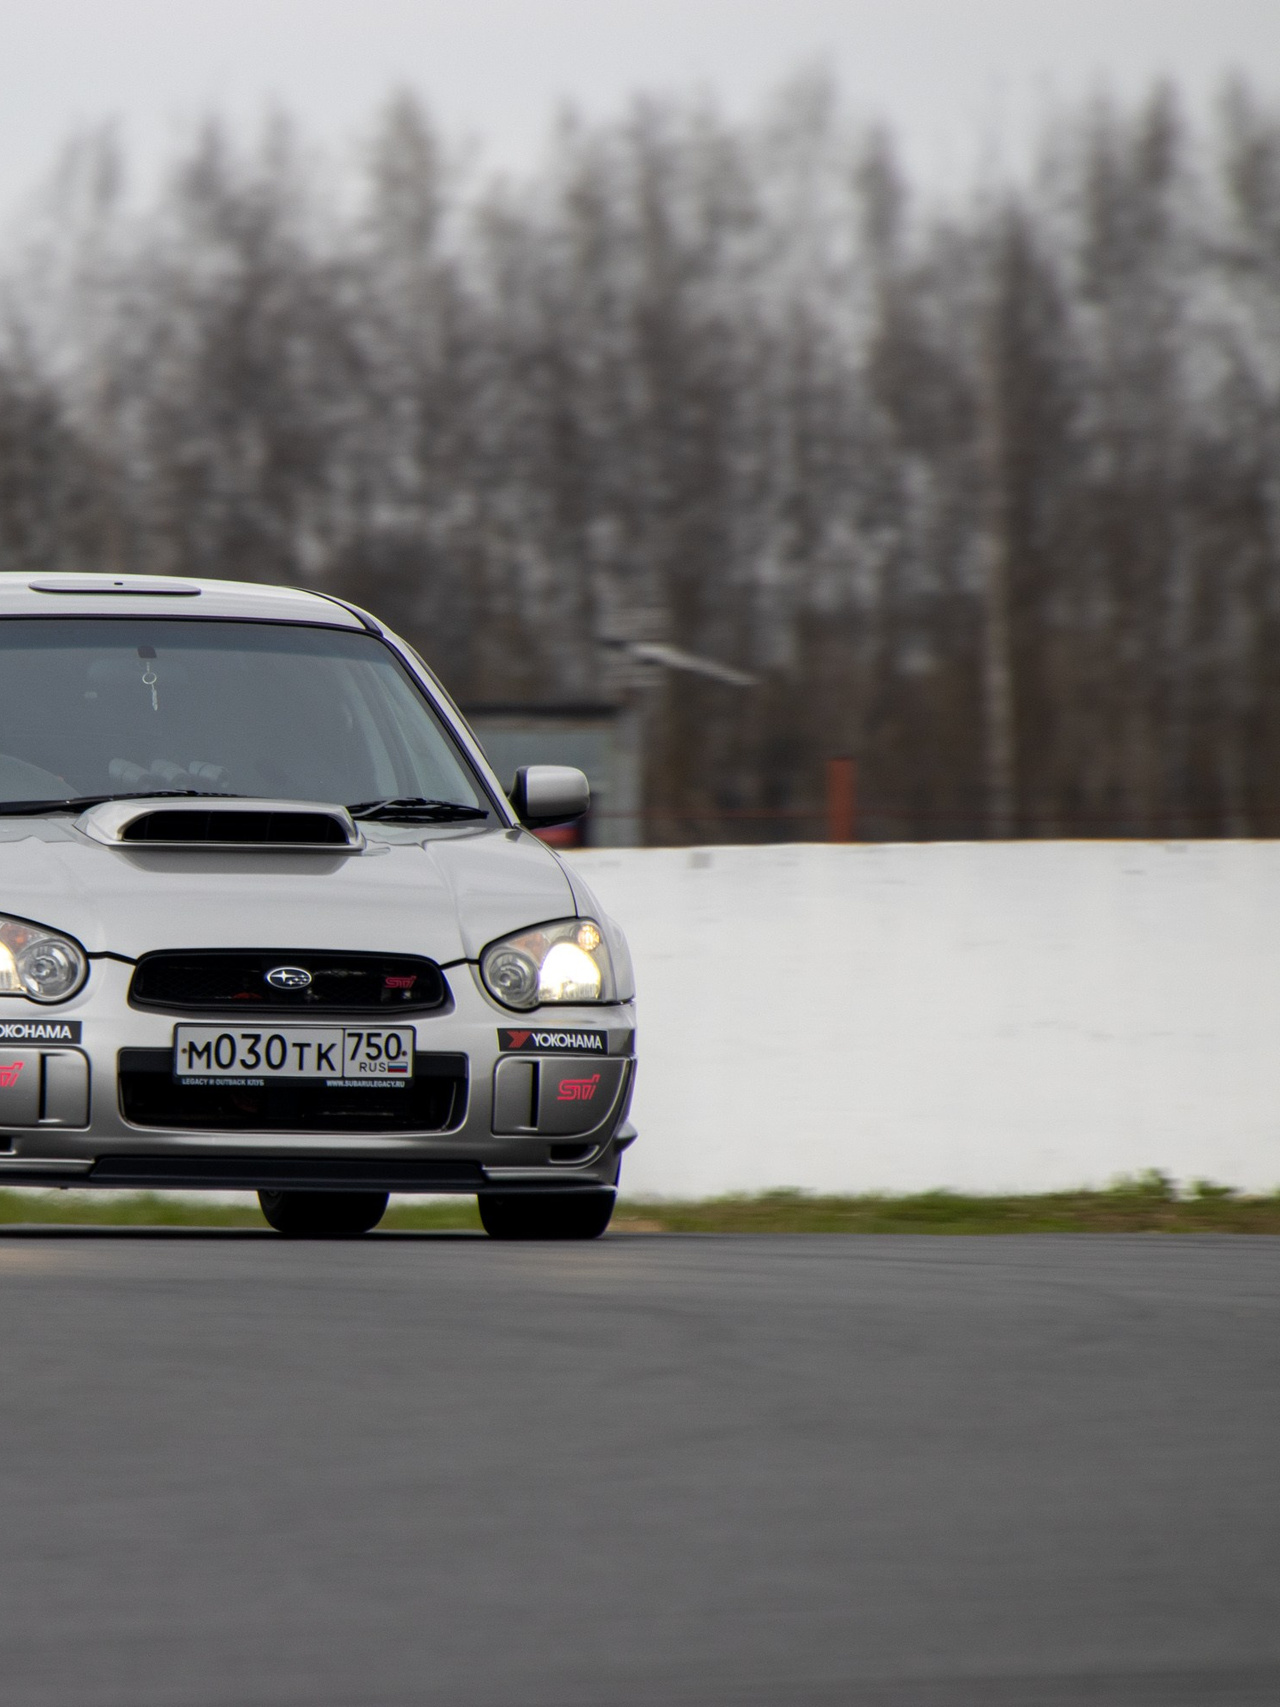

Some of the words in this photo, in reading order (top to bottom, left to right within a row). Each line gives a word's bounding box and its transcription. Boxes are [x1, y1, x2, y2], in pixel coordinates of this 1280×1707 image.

[346, 1032, 402, 1061] 750
[531, 1032, 603, 1050] YOKOHAMA
[359, 1061, 387, 1073] RUS
[182, 1078, 208, 1086] LEGACY
[216, 1079, 246, 1087] OUTBACK
[326, 1080, 405, 1088] WWW.SUBARULEGACY.RU
